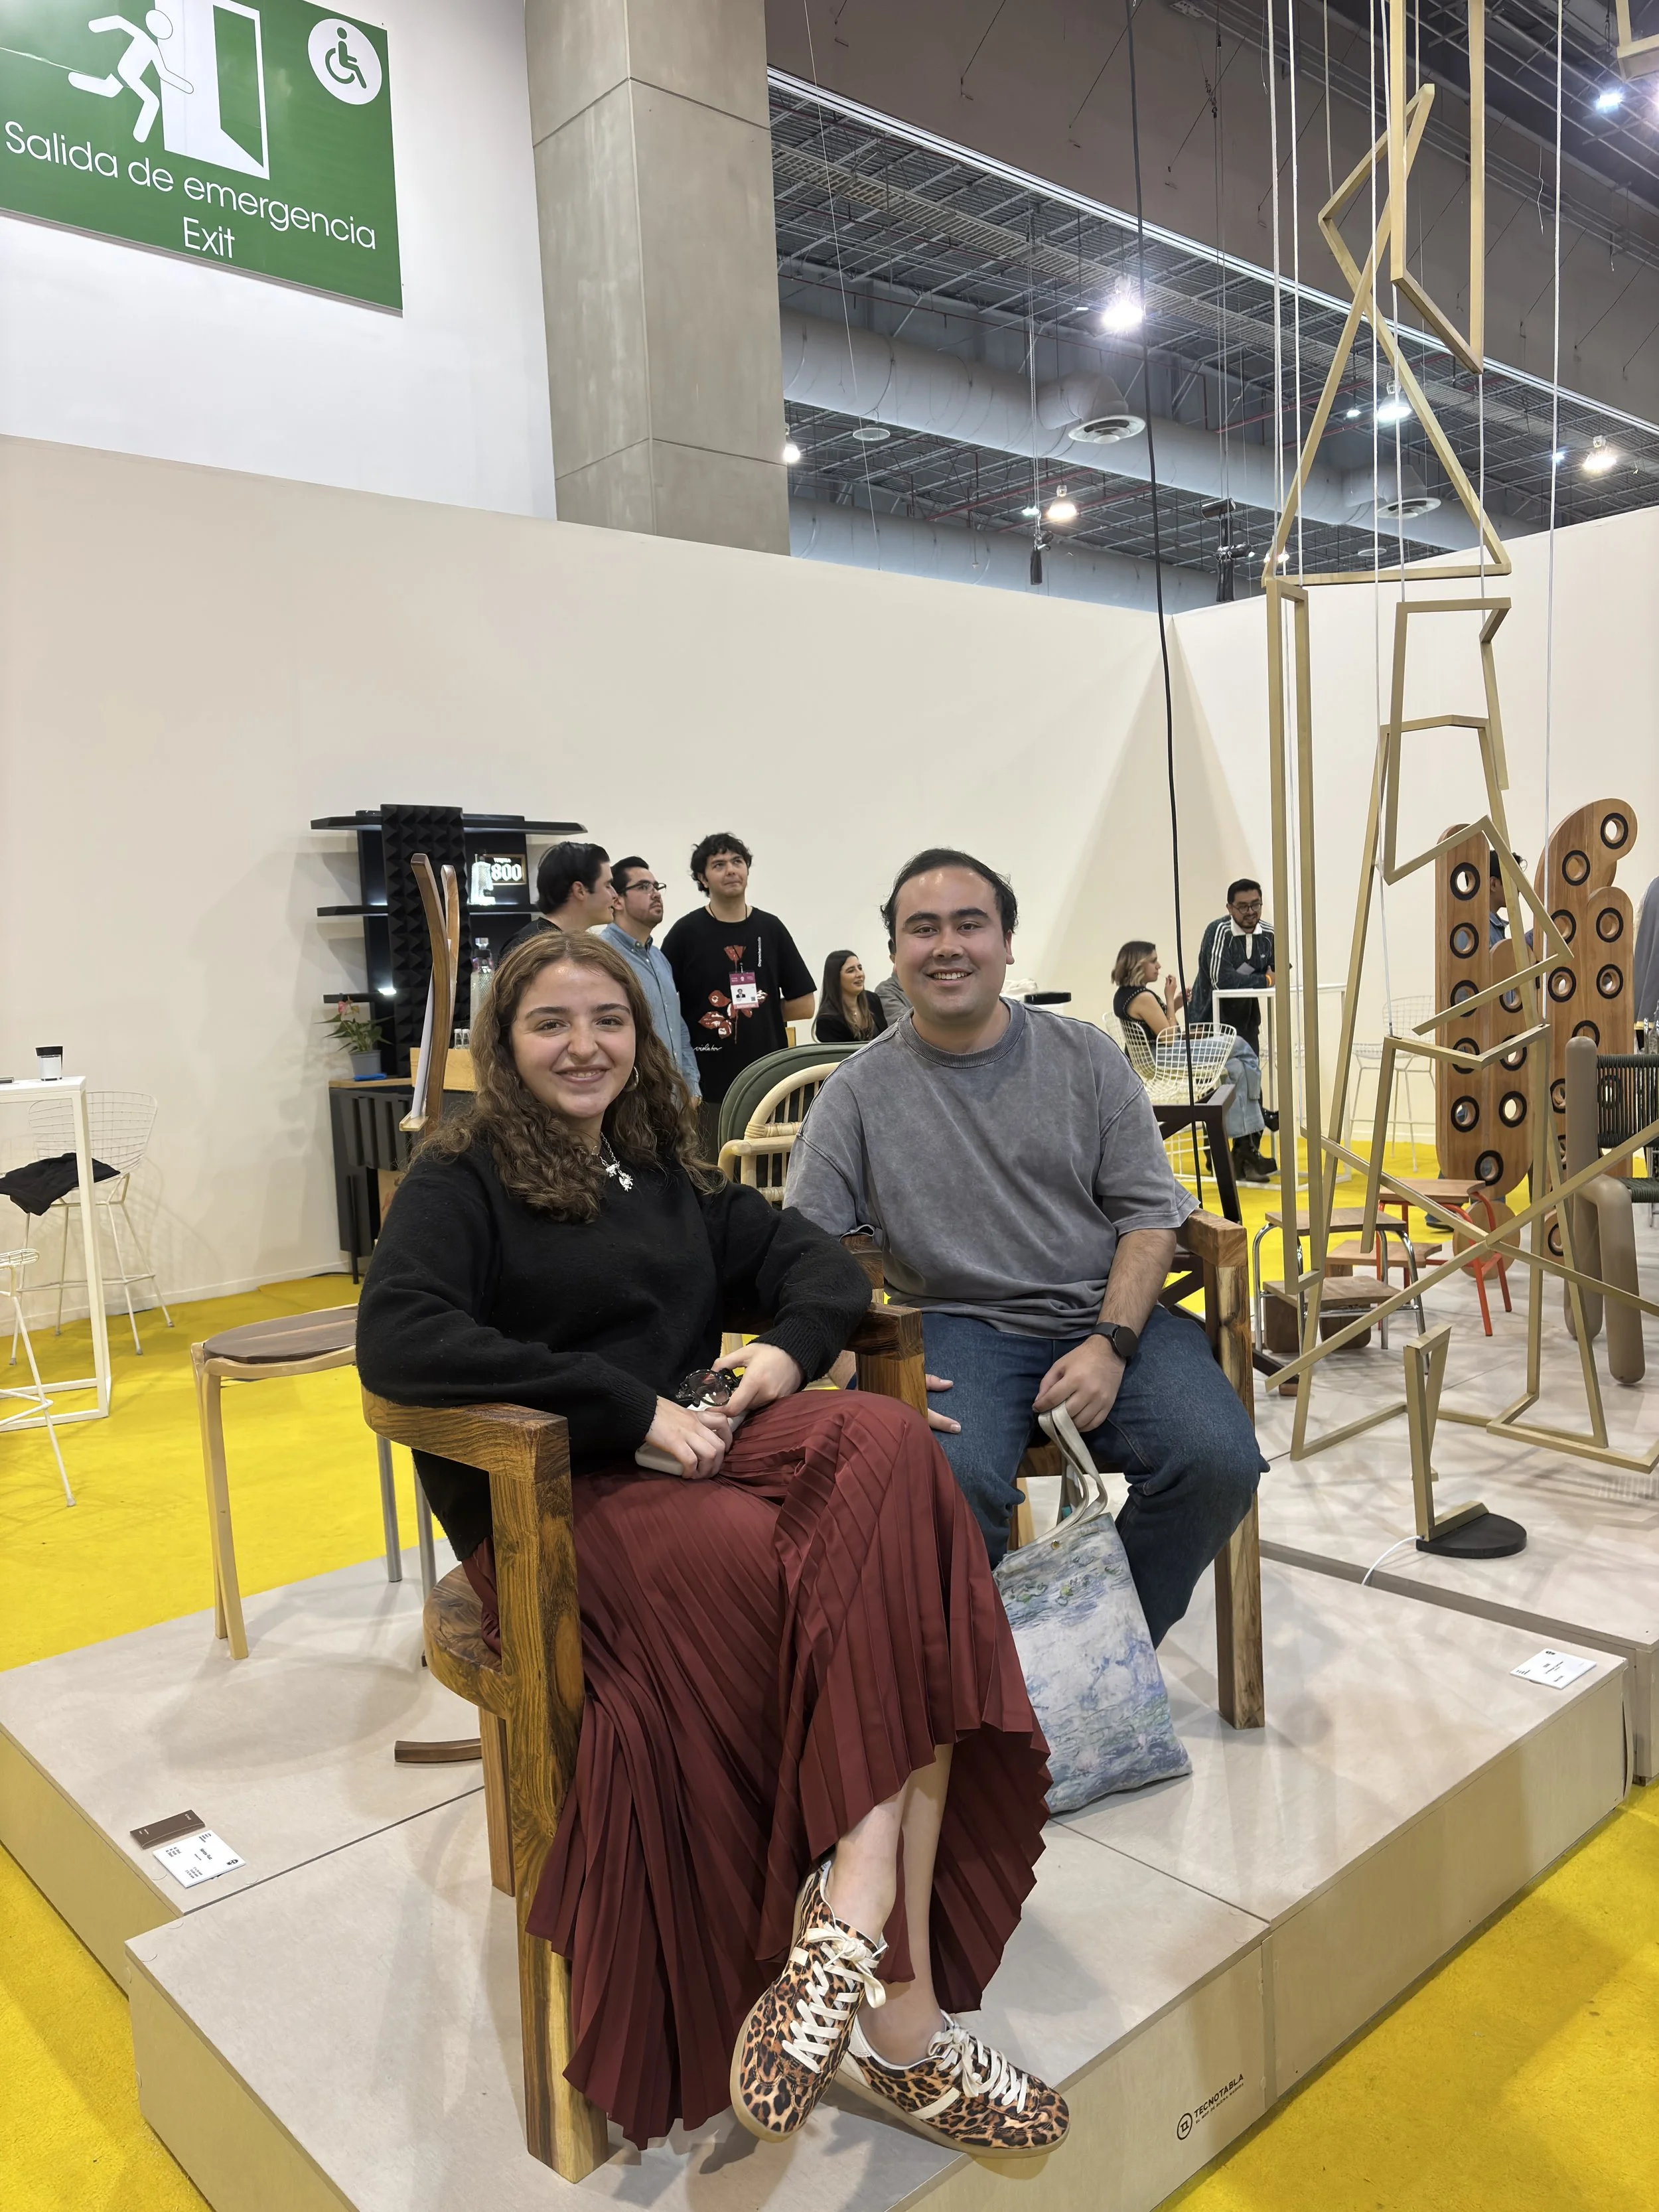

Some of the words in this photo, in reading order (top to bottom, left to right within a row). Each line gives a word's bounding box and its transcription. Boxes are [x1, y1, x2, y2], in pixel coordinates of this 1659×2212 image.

[5, 121, 118, 179] Salida
[127, 157, 174, 192] de
[184, 177, 376, 250] emergencia
[182, 216, 236, 259] Exit
[1194, 2073, 1244, 2118] TECNOTABLA
